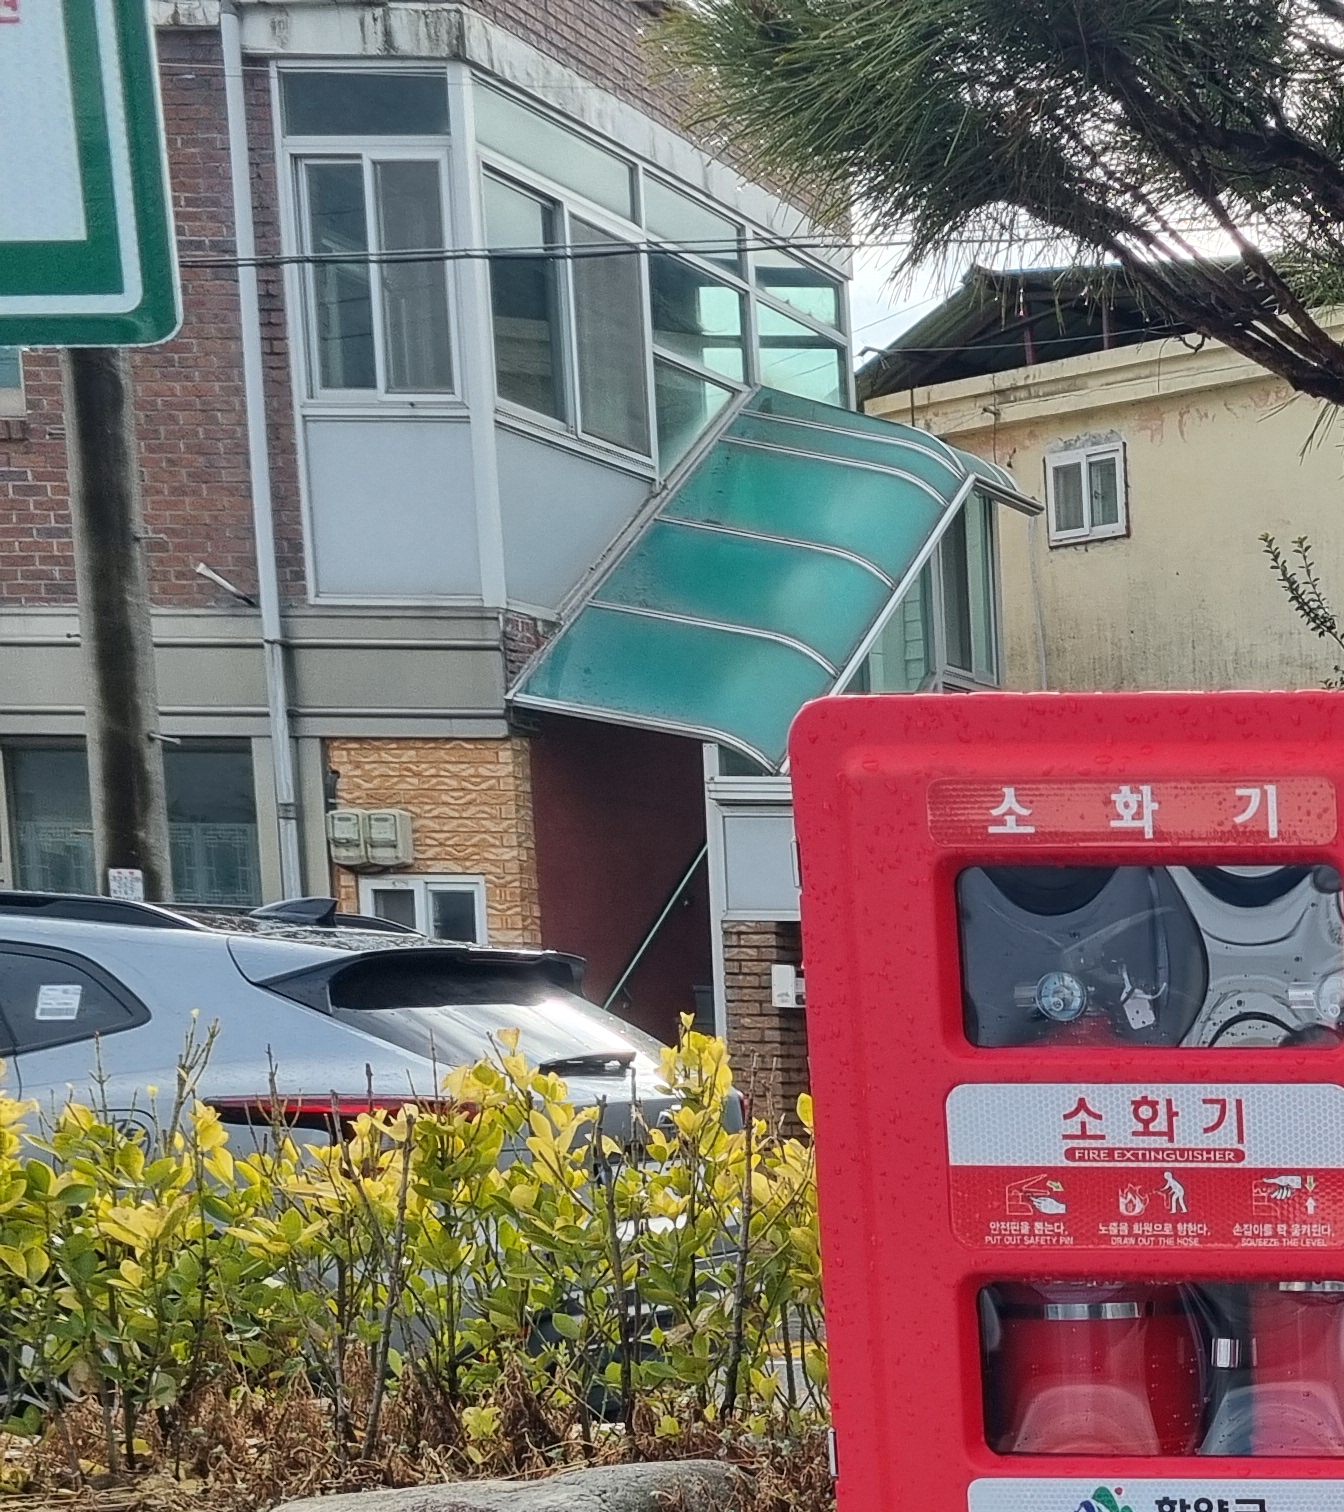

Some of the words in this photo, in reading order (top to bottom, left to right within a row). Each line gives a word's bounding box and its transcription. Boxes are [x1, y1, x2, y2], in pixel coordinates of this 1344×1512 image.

[1061, 1095, 1245, 1145] 소화기
[1075, 1149, 1110, 1161] FIRE
[1115, 1149, 1236, 1162] EXTINGUISHER
[984, 1235, 1002, 1245] PUT
[1004, 1235, 1022, 1245] OUT
[1023, 1235, 1057, 1246] SAFETY
[1110, 1237, 1136, 1246] DRAW
[1137, 1237, 1156, 1247] OUT
[1158, 1237, 1175, 1247] THE
[1176, 1237, 1200, 1247] HOSE
[1282, 1238, 1299, 1248] THE
[1301, 1238, 1328, 1248] LEVEL
